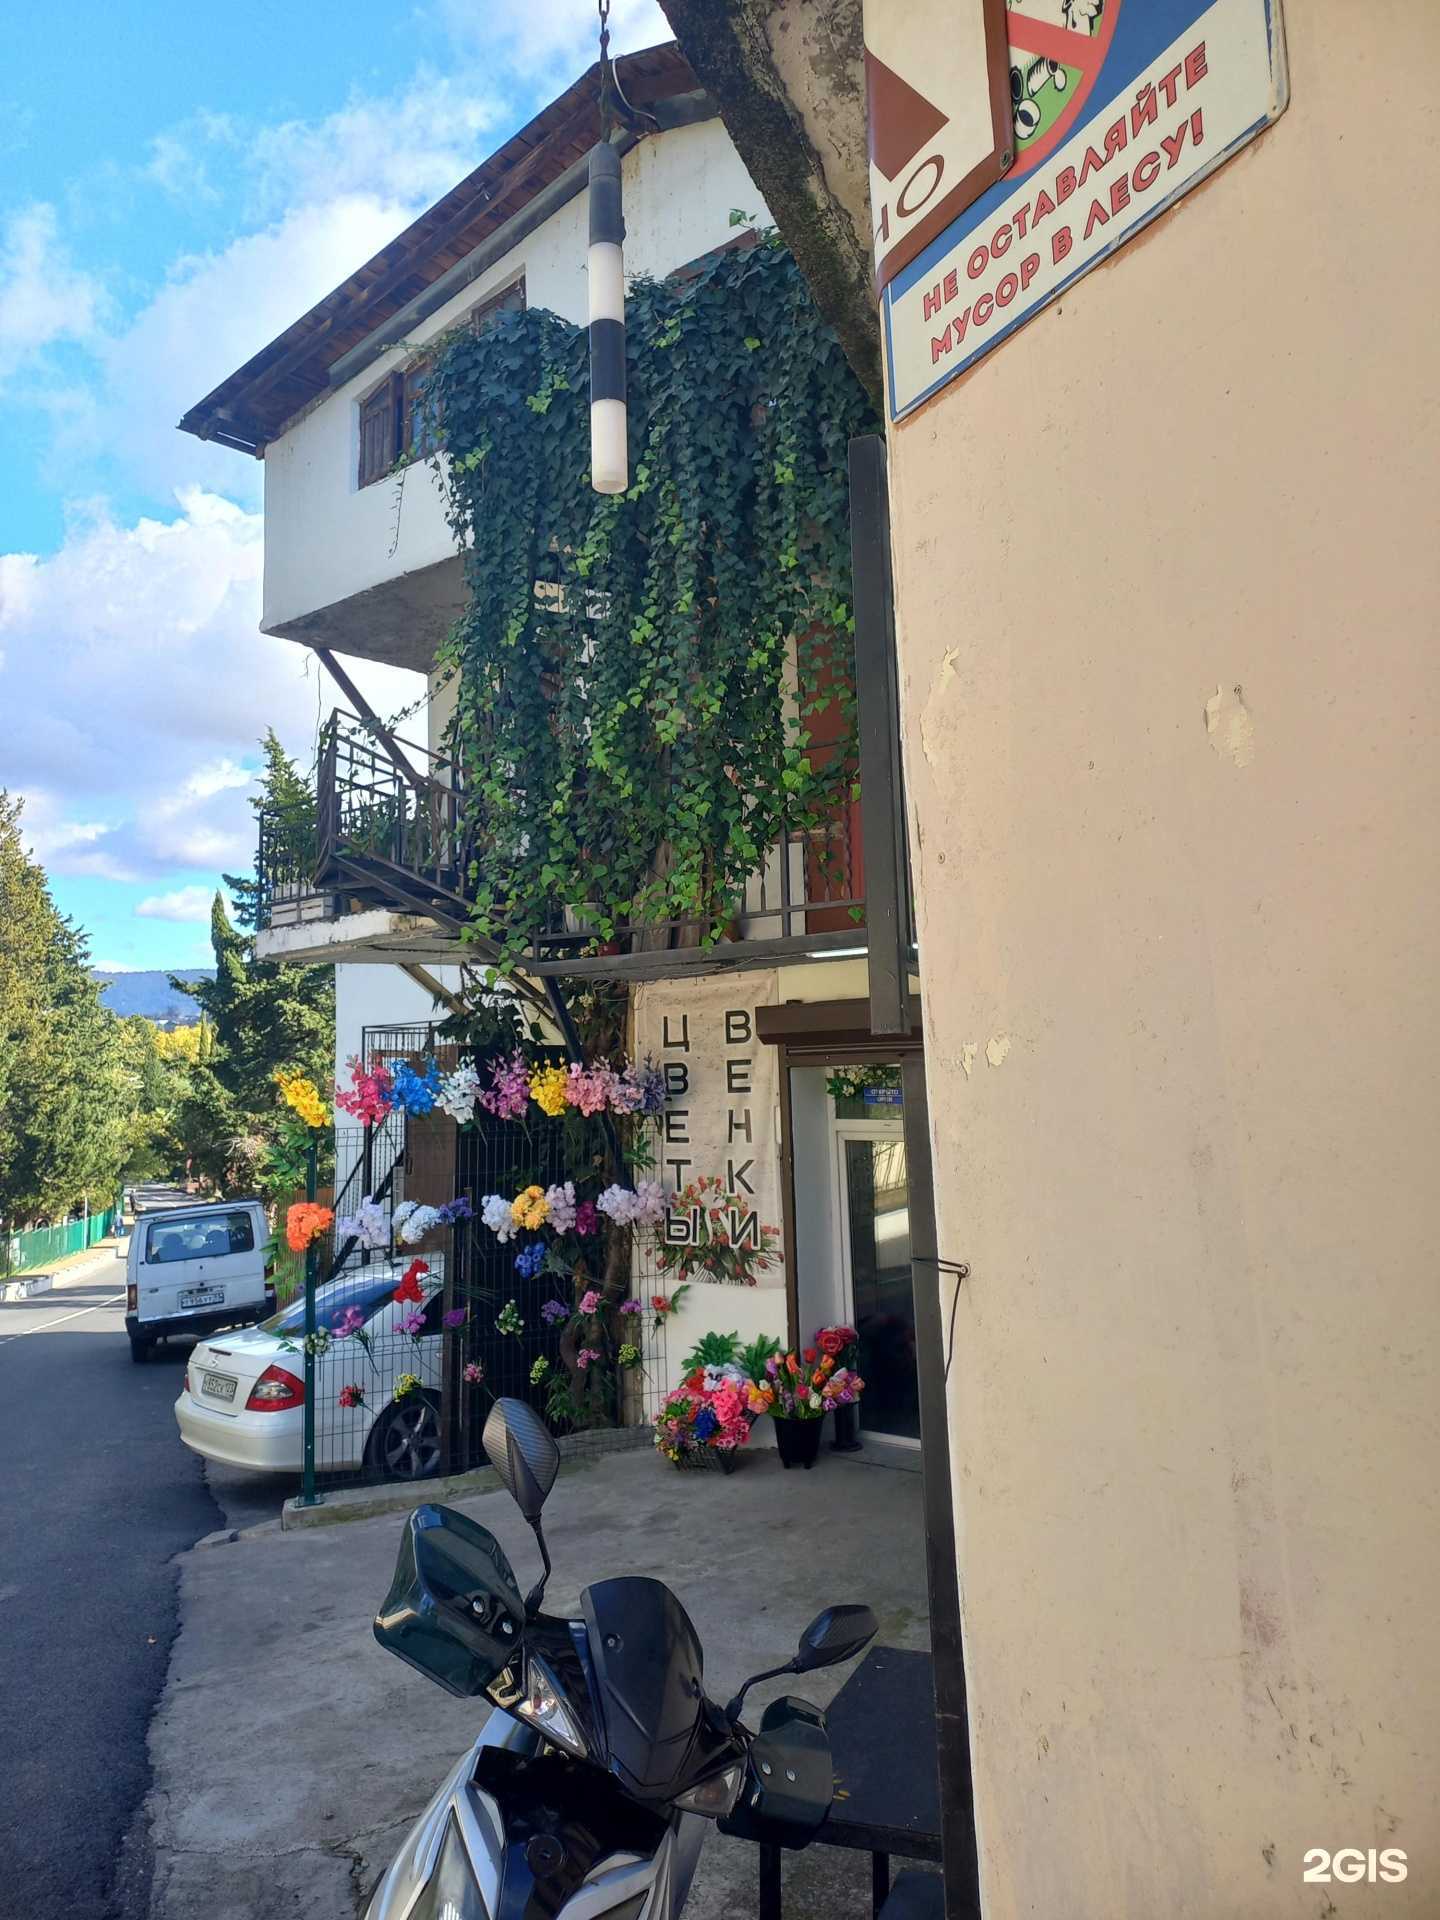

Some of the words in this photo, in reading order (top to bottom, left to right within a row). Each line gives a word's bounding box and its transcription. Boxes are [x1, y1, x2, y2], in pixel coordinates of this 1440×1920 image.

[922, 268, 959, 323] НЕ
[966, 41, 1209, 280] ОСТАВЛЯЙТЕ
[930, 253, 1041, 364] МУСОР
[1052, 225, 1073, 266] В
[1083, 108, 1205, 241] ЛЕСУ!
[663, 1014, 698, 1245] ЦВЕТЫ
[724, 1009, 758, 1247] ВЕНКИ
